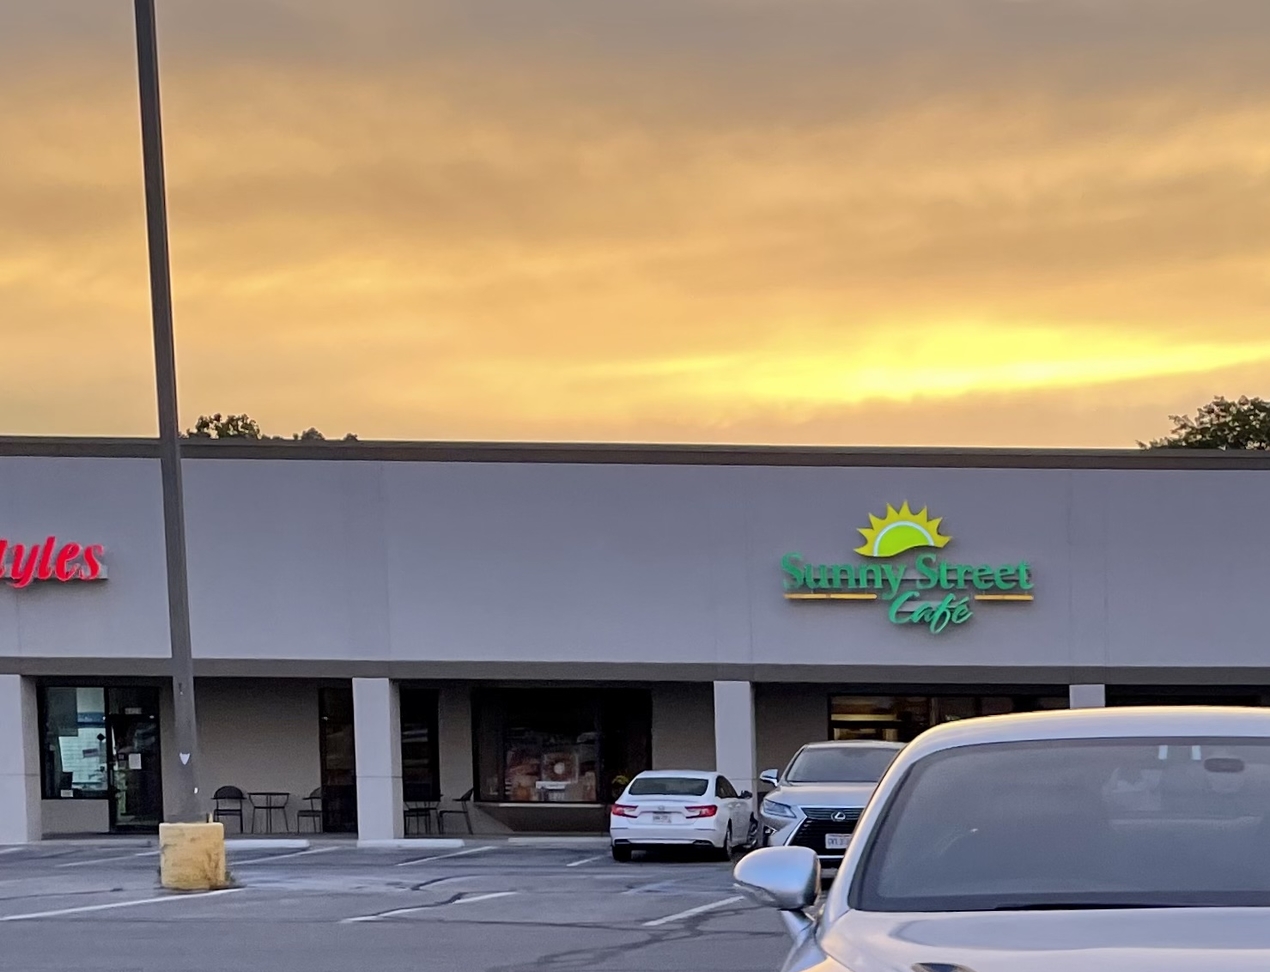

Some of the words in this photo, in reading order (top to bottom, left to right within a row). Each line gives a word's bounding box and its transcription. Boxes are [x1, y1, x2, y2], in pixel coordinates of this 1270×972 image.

[0, 536, 104, 590] yles
[780, 551, 907, 600] Sunny
[915, 552, 1034, 590] Street
[888, 590, 974, 634] Café
